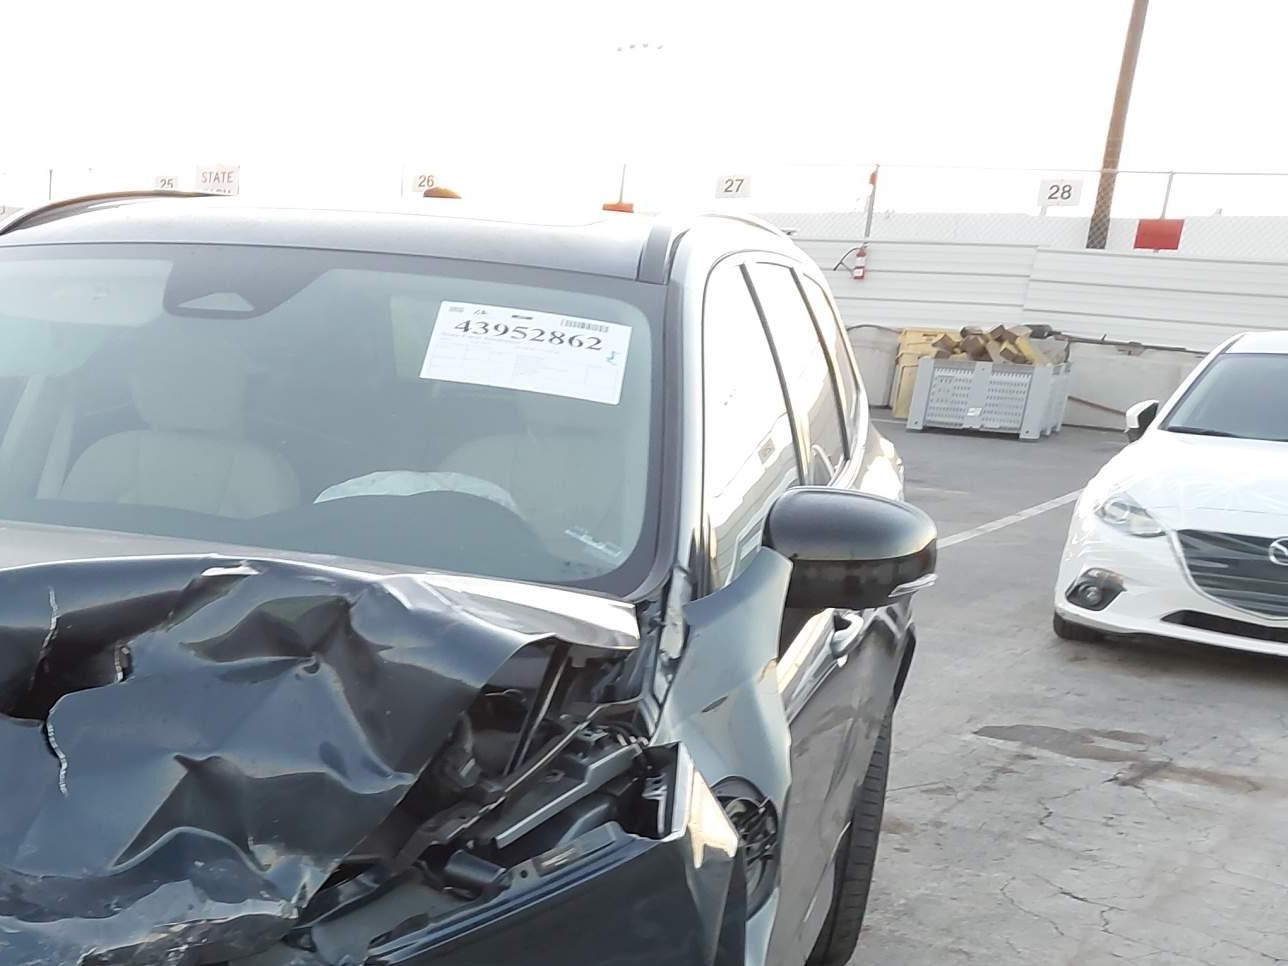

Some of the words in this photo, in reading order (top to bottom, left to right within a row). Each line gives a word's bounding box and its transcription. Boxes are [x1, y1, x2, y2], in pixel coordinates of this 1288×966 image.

[159, 178, 174, 189] 25
[200, 170, 234, 184] STATE
[418, 174, 435, 188] 26
[723, 178, 744, 193] 27
[1047, 184, 1073, 200] 28
[453, 319, 603, 351] 43952862
